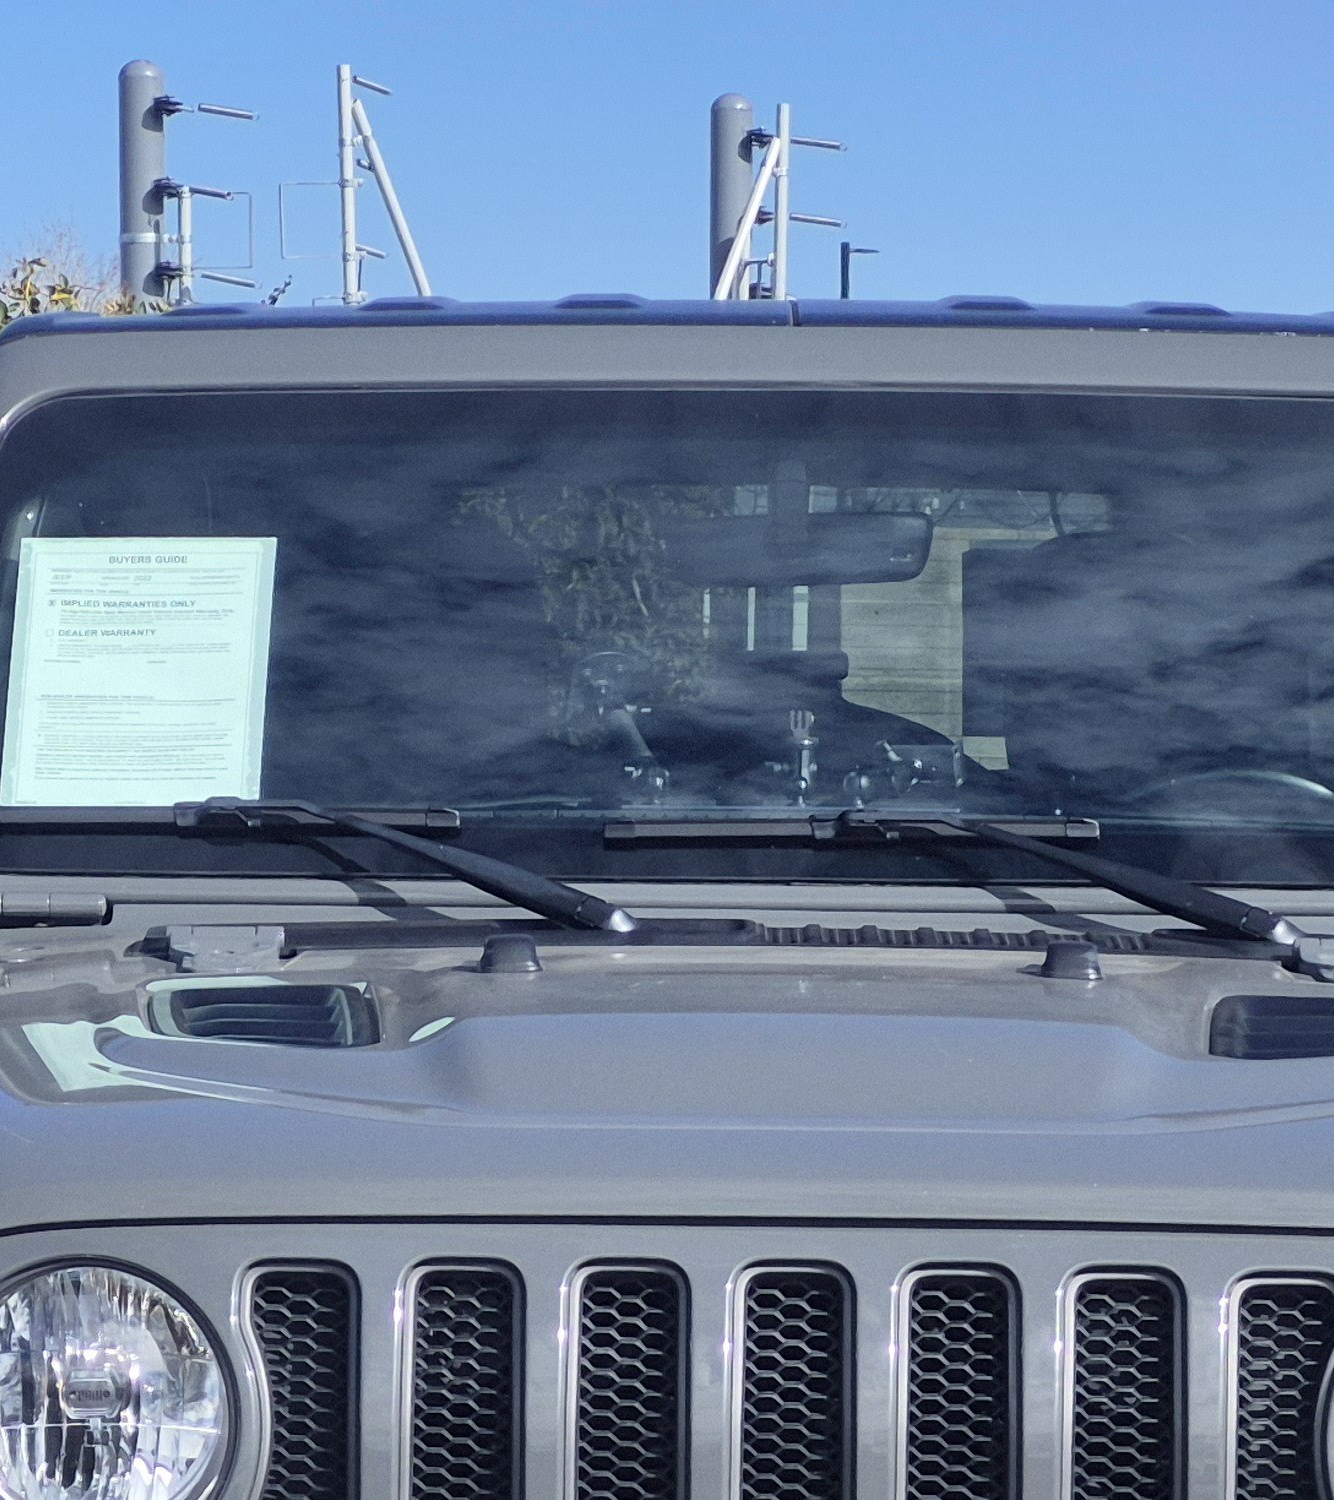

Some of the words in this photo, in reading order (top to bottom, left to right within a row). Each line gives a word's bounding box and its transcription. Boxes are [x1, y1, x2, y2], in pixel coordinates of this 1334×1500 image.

[108, 555, 152, 565] BUYERS
[155, 555, 188, 564] GUIDE
[60, 599, 100, 608] IMPLIED
[102, 600, 167, 609] WARRANTIES
[169, 600, 196, 608] ONLY
[58, 629, 98, 637] DEALER
[101, 628, 157, 637] WARRANTY
